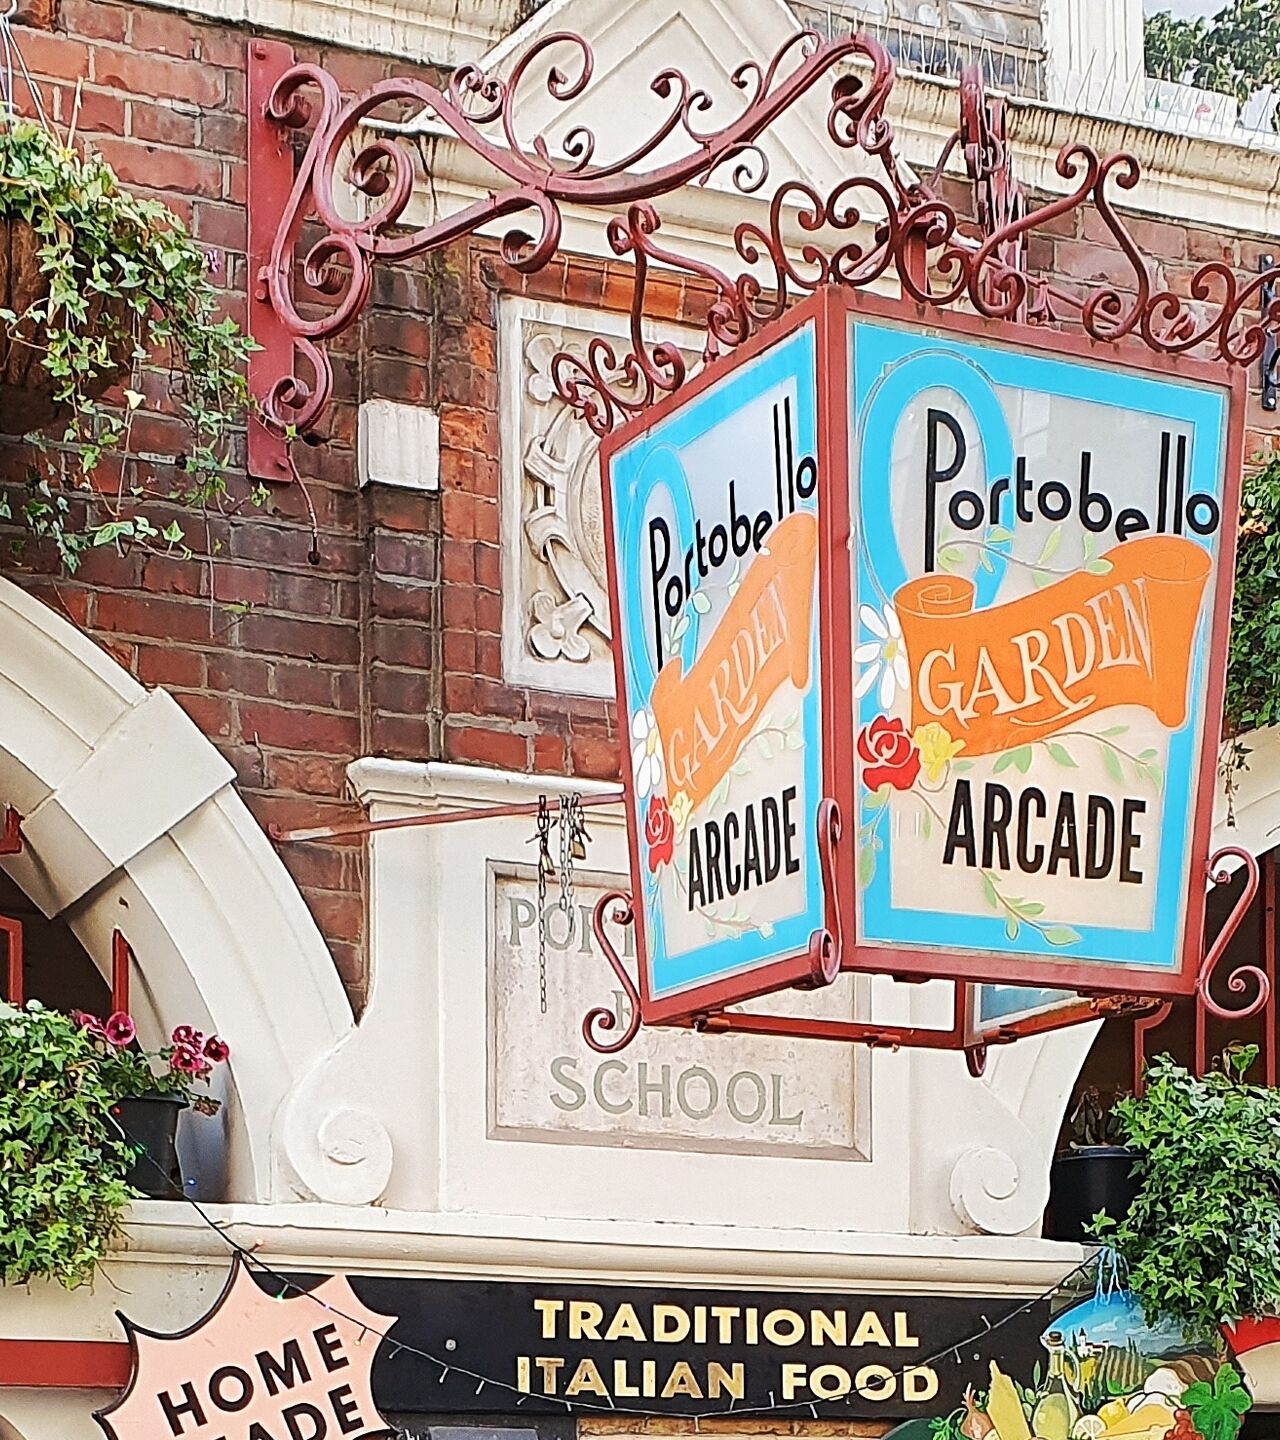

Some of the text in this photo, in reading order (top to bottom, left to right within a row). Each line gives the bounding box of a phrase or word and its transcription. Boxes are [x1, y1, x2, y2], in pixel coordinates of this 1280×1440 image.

[649, 397, 817, 669] Portobello
[925, 408, 1220, 572] Portobello
[669, 576, 789, 789] GARDEN
[918, 578, 1153, 730] GARDEN
[688, 787, 800, 911] ARCADE
[943, 779, 1147, 884] ARCADE
[550, 1056, 803, 1126] SCHOOL
[157, 1323, 349, 1437] HOME
[517, 1356, 939, 1401] ITALIAN FOOD
[534, 1300, 919, 1347] TRADITIONAL
